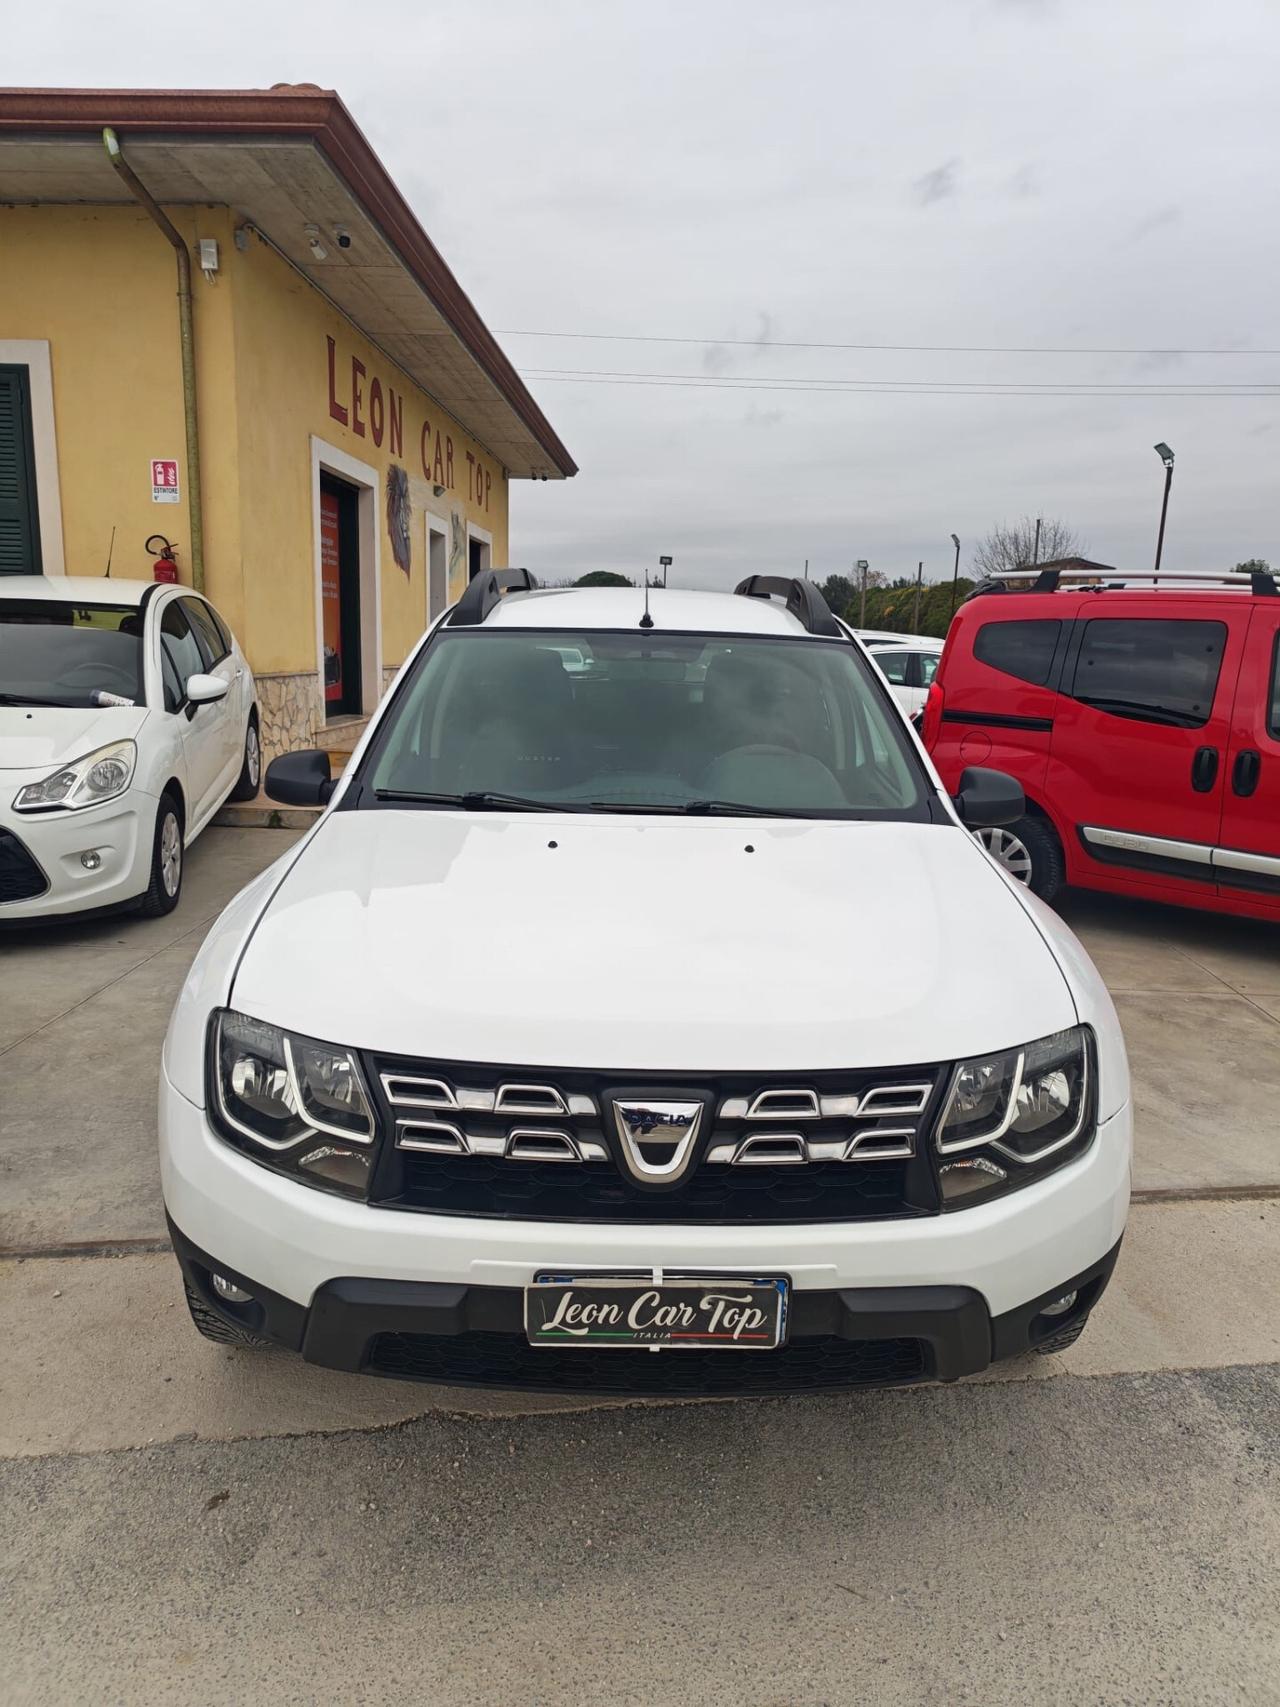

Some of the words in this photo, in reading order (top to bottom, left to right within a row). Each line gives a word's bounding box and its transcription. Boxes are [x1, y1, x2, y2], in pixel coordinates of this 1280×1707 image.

[326, 335, 403, 459] LEON
[420, 420, 455, 490] CAR
[465, 450, 492, 513] TOP
[630, 1114, 688, 1126] DACIA
[541, 1291, 624, 1336] Leon
[627, 1290, 697, 1330] Car
[699, 1294, 768, 1341] Top
[632, 1332, 672, 1340] ITALIA
